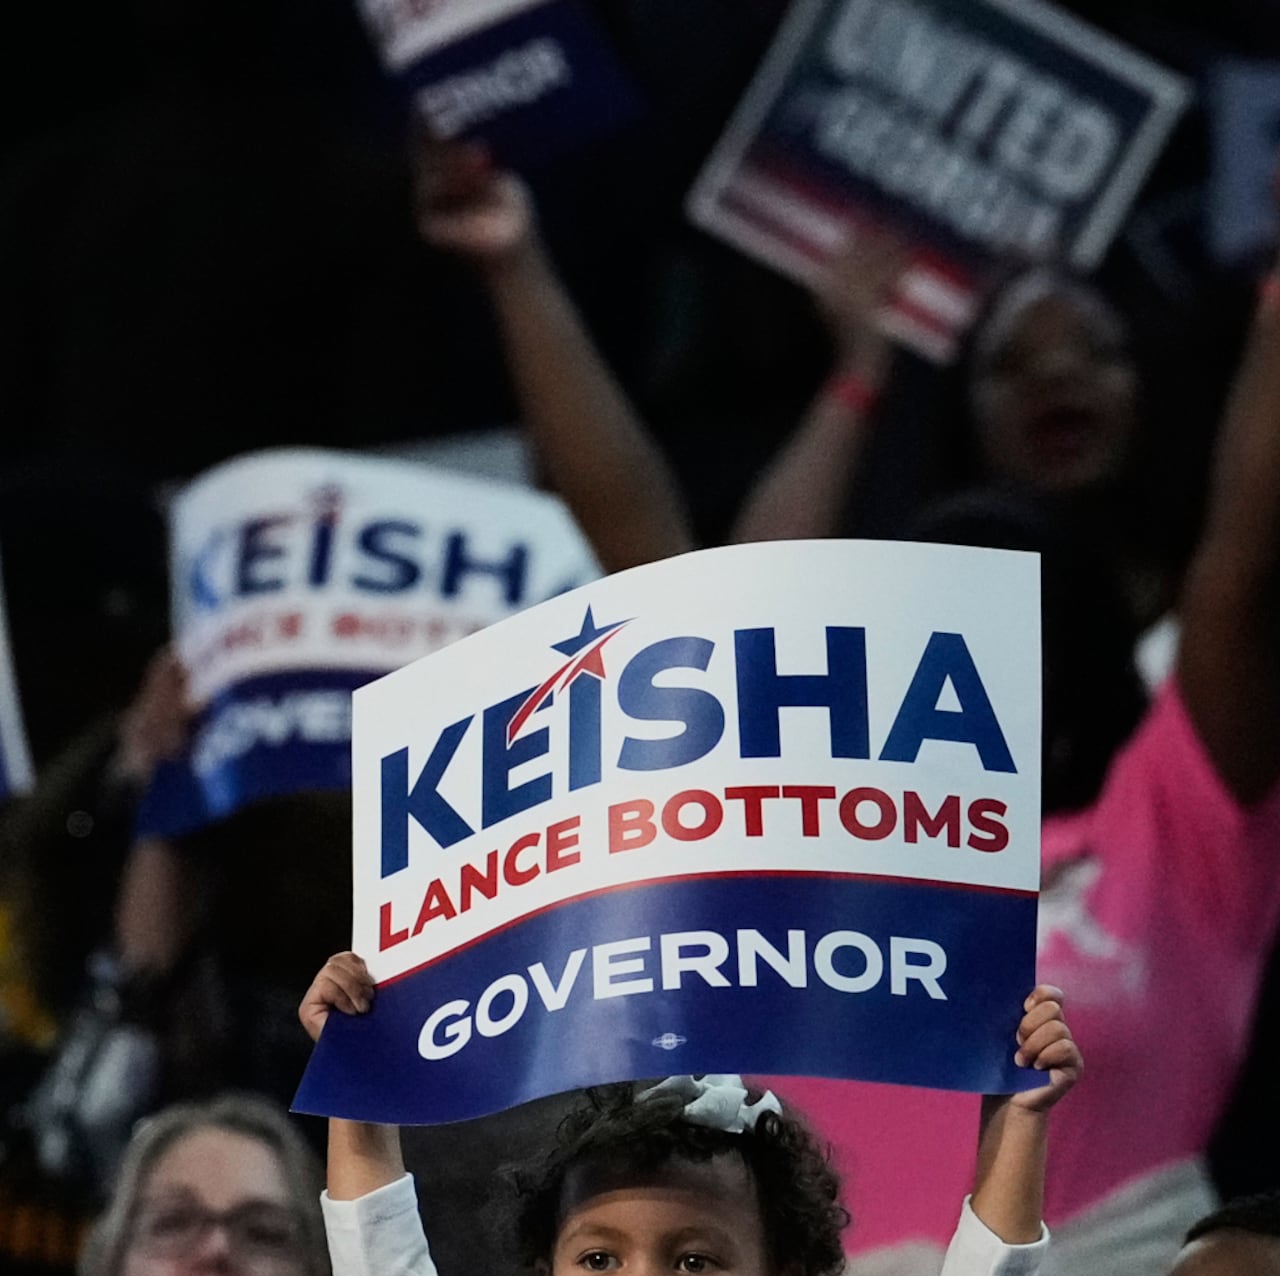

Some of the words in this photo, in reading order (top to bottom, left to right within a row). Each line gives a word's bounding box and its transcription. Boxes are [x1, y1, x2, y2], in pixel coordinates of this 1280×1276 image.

[190, 484, 577, 618] KEISH
[379, 603, 1019, 880] KEISHA
[377, 816, 583, 953] LANCE
[606, 784, 1011, 854] BOTTOMS
[417, 928, 950, 1061] GOVERNOR
